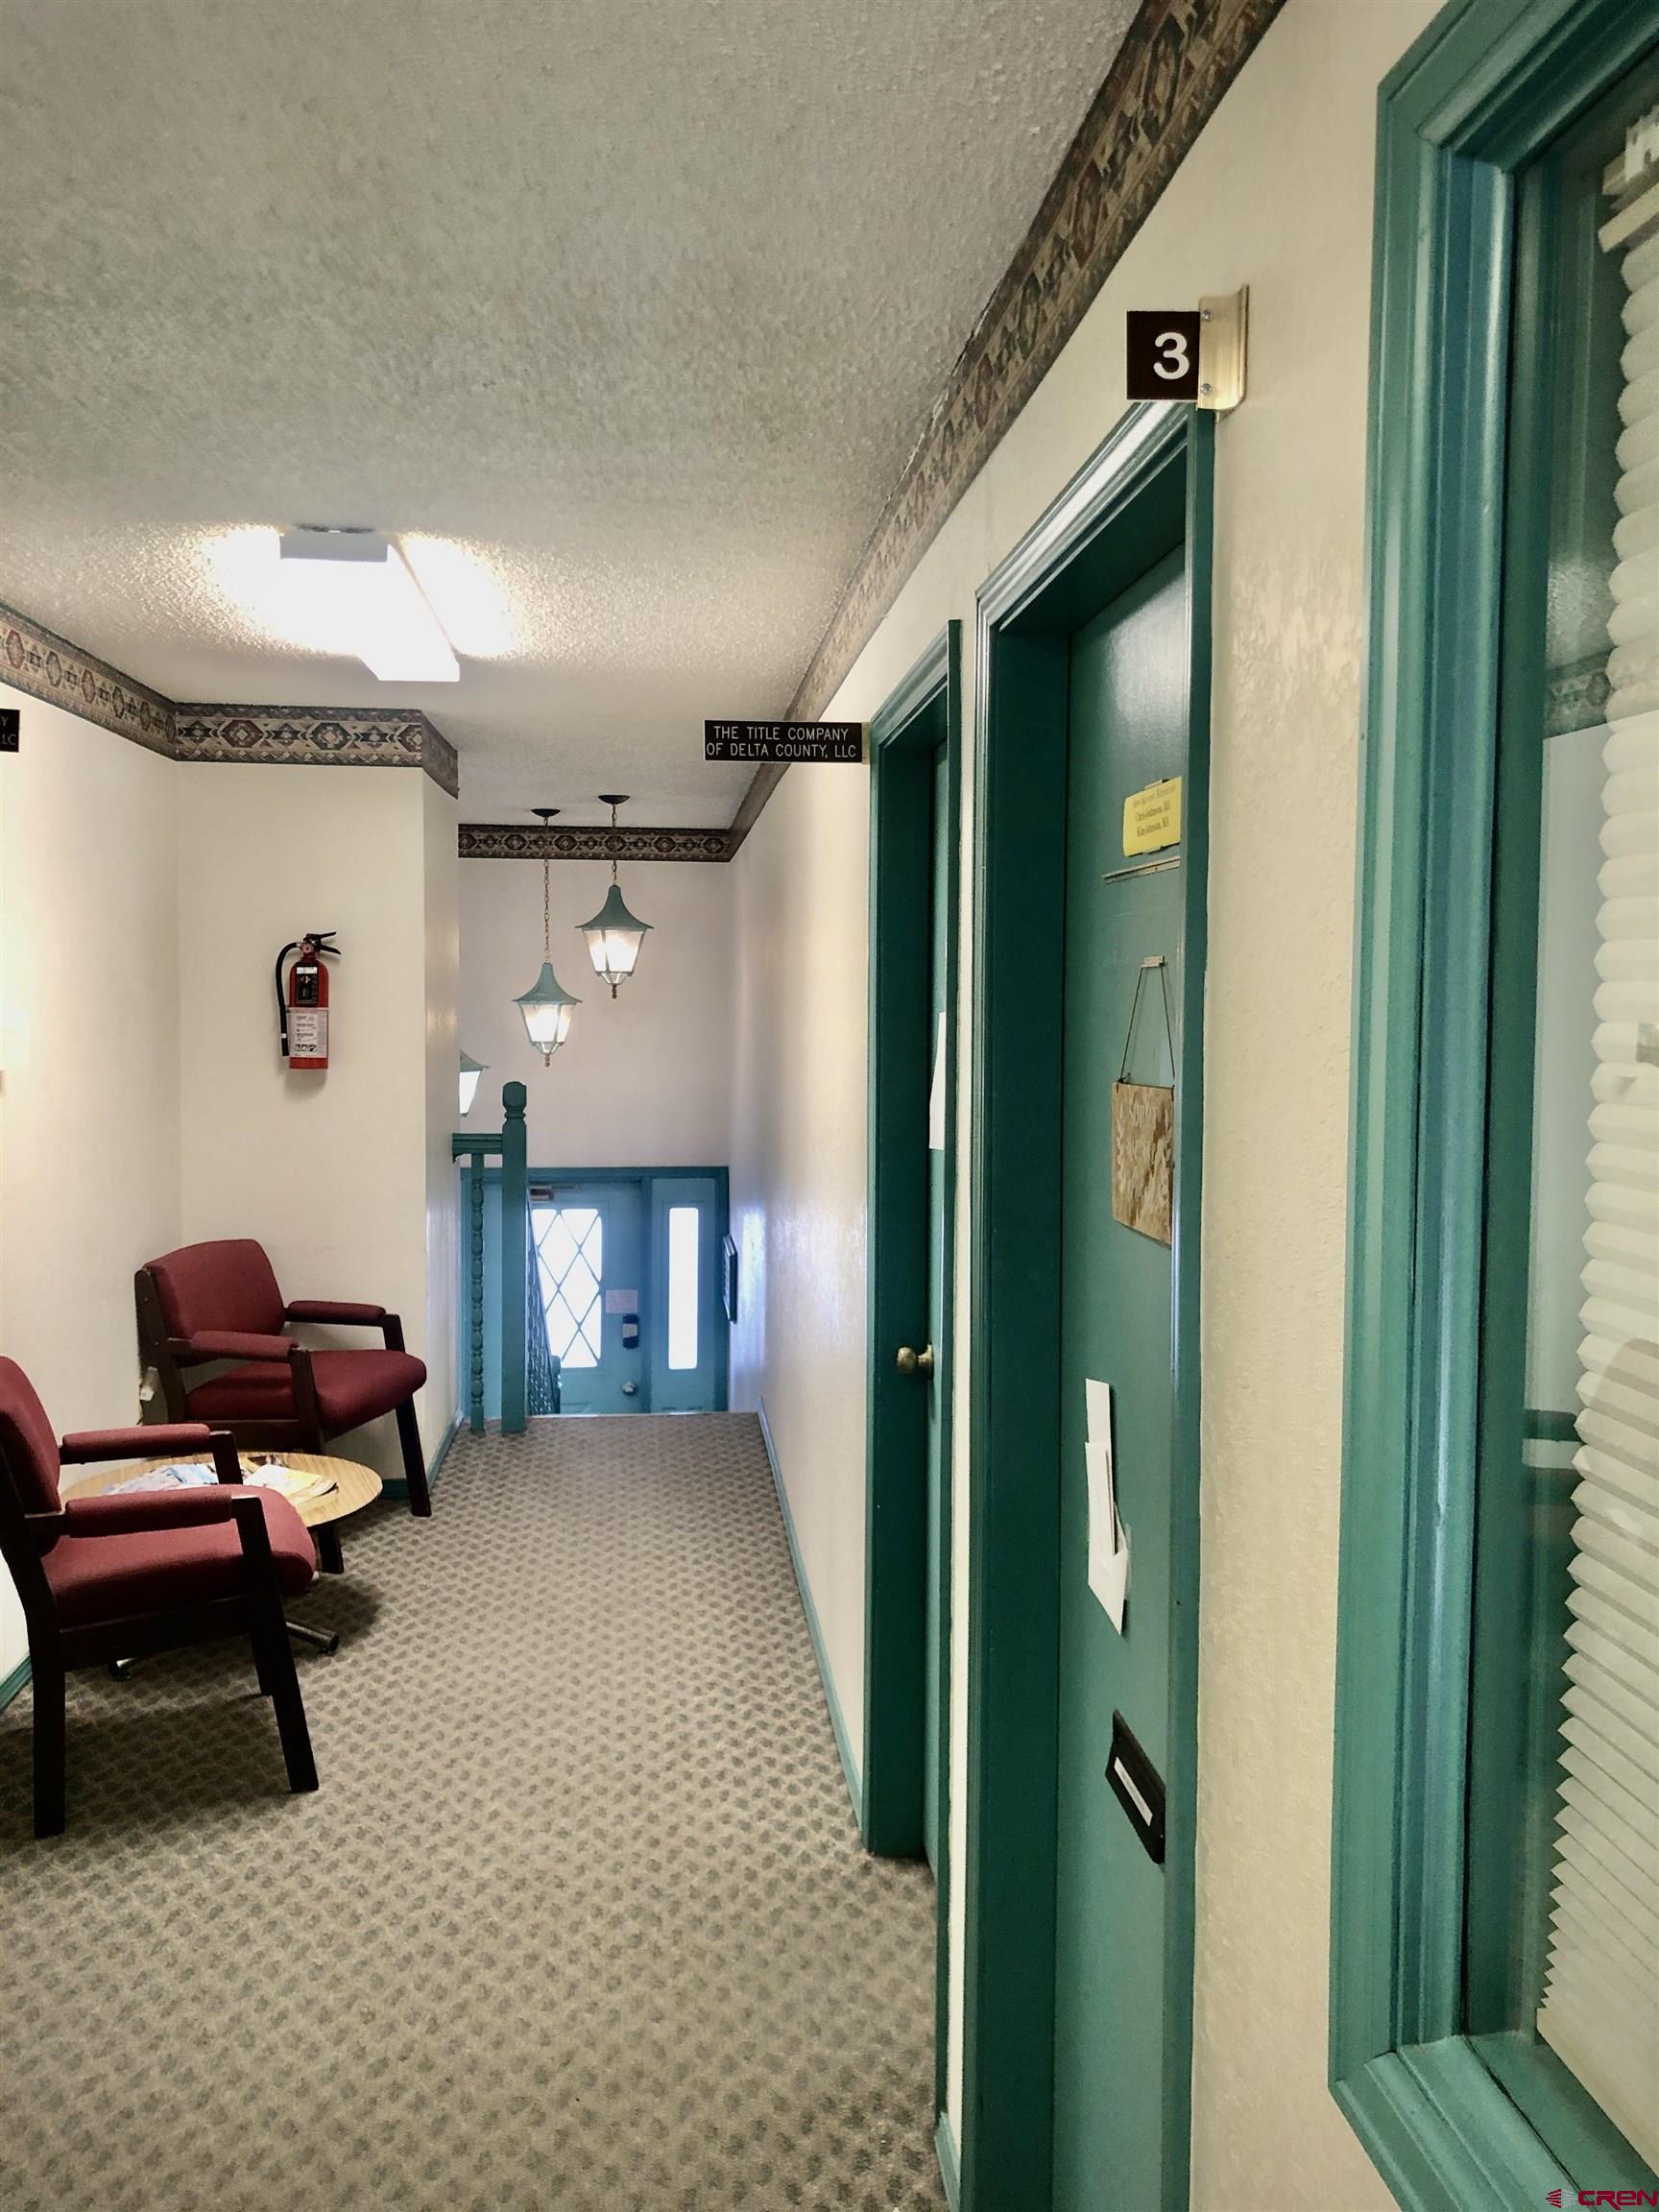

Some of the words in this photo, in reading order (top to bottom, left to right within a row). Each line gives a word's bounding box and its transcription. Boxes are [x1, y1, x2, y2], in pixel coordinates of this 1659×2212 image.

[1153, 331, 1190, 380] 3
[713, 726, 739, 740] THE
[746, 727, 781, 741] TITLE
[787, 728, 849, 741] COMPANY
[706, 742, 724, 757] OF
[730, 743, 769, 757] DELTA
[775, 744, 829, 758] COUNTY,
[834, 745, 856, 757] LLC
